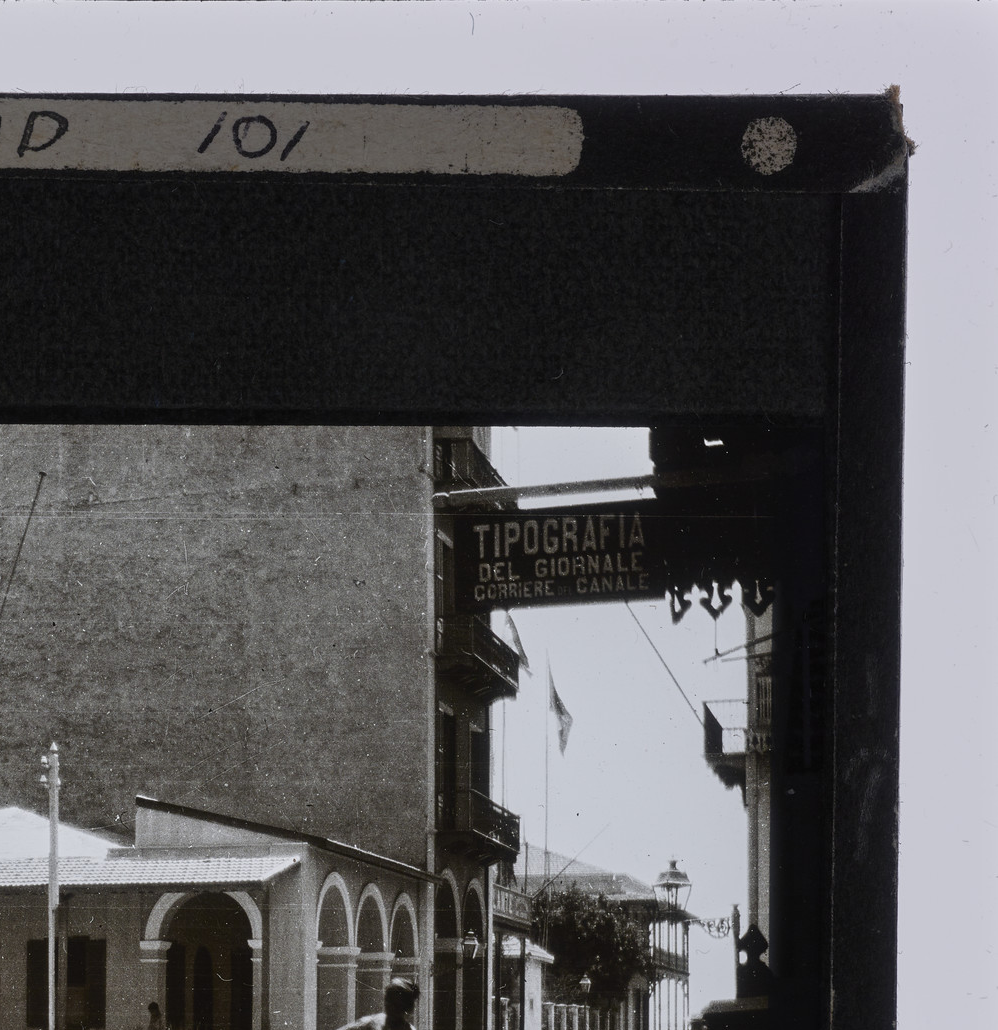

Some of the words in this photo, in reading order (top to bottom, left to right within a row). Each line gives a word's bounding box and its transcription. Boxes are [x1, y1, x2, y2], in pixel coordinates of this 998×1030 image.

[198, 111, 310, 163] 101
[473, 512, 644, 559] TIPOGRAFIA
[479, 561, 520, 583] DEL
[535, 551, 643, 578] GIORNALE
[475, 580, 555, 602] CORRIERE
[576, 573, 650, 594] CANALE
